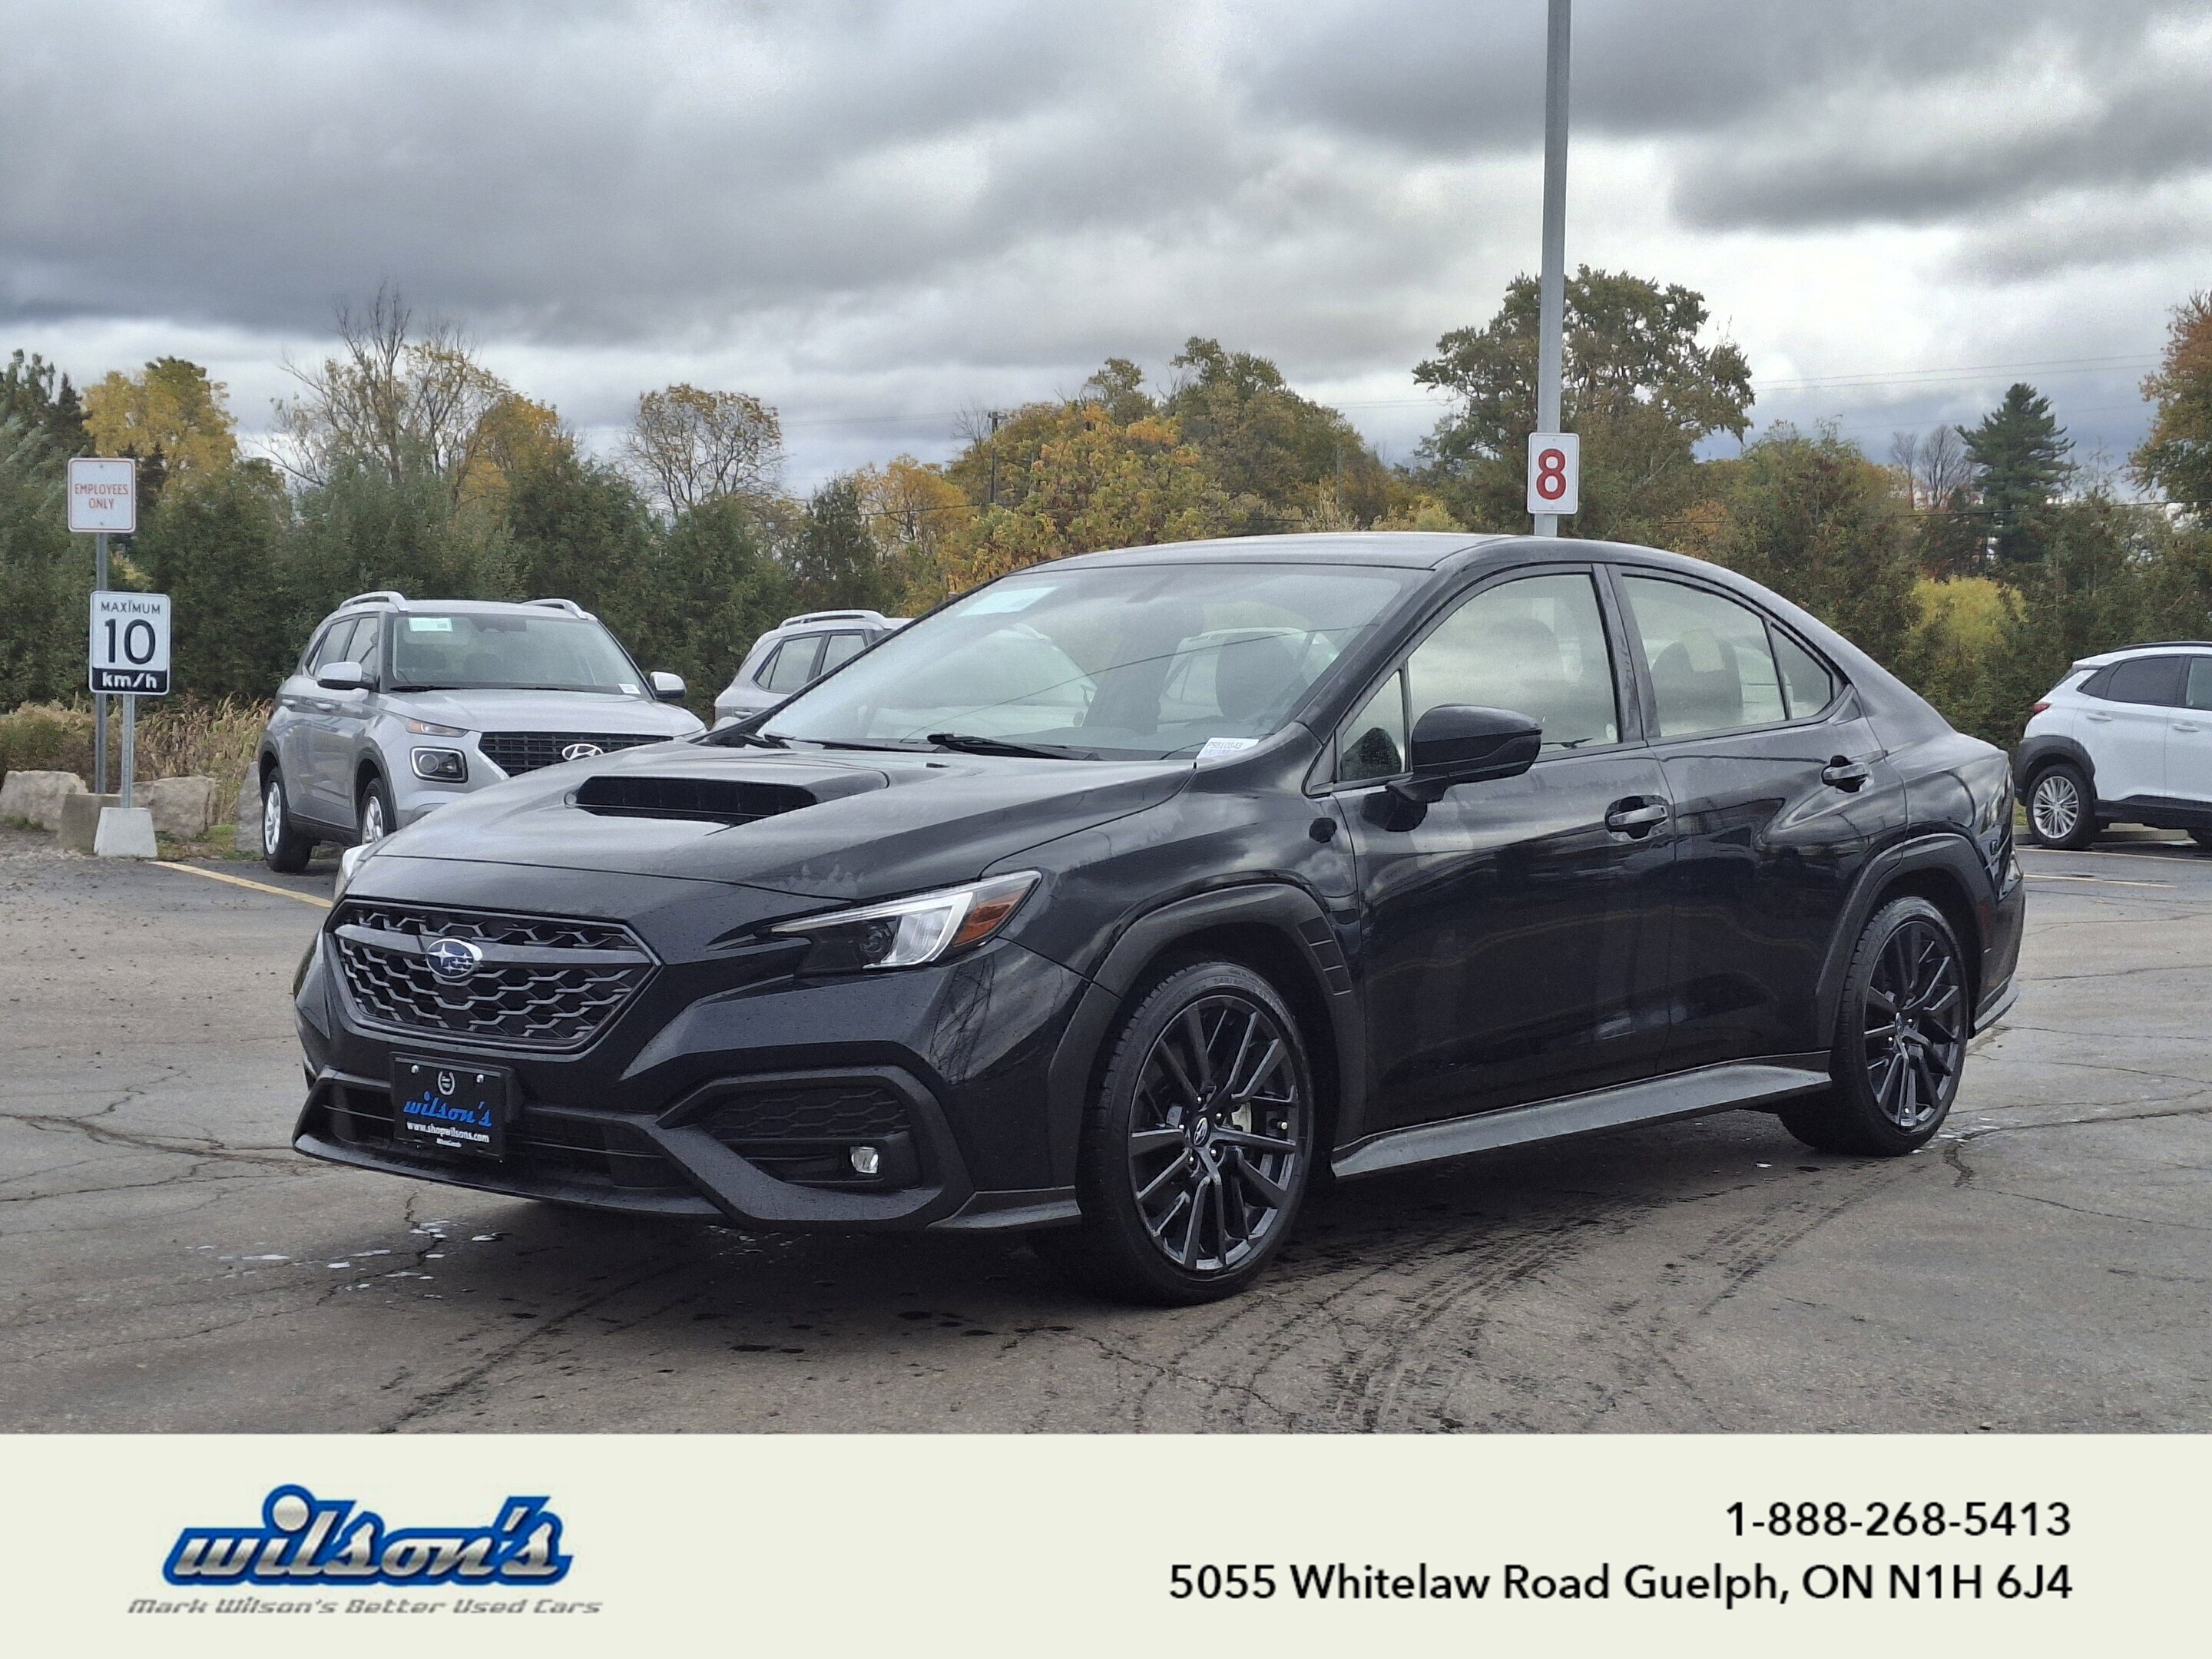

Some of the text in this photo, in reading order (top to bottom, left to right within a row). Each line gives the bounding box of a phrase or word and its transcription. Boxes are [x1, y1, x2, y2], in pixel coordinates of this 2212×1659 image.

[1536, 448, 1567, 500] 8
[75, 483, 129, 495] EMPLOYEES
[88, 498, 114, 510] ONLY
[100, 601, 161, 614] MAXIMUM
[104, 618, 156, 664] 10
[101, 672, 157, 689] km/h
[403, 1091, 492, 1127] wilson's
[406, 1121, 490, 1143] www.shopwilsons.com
